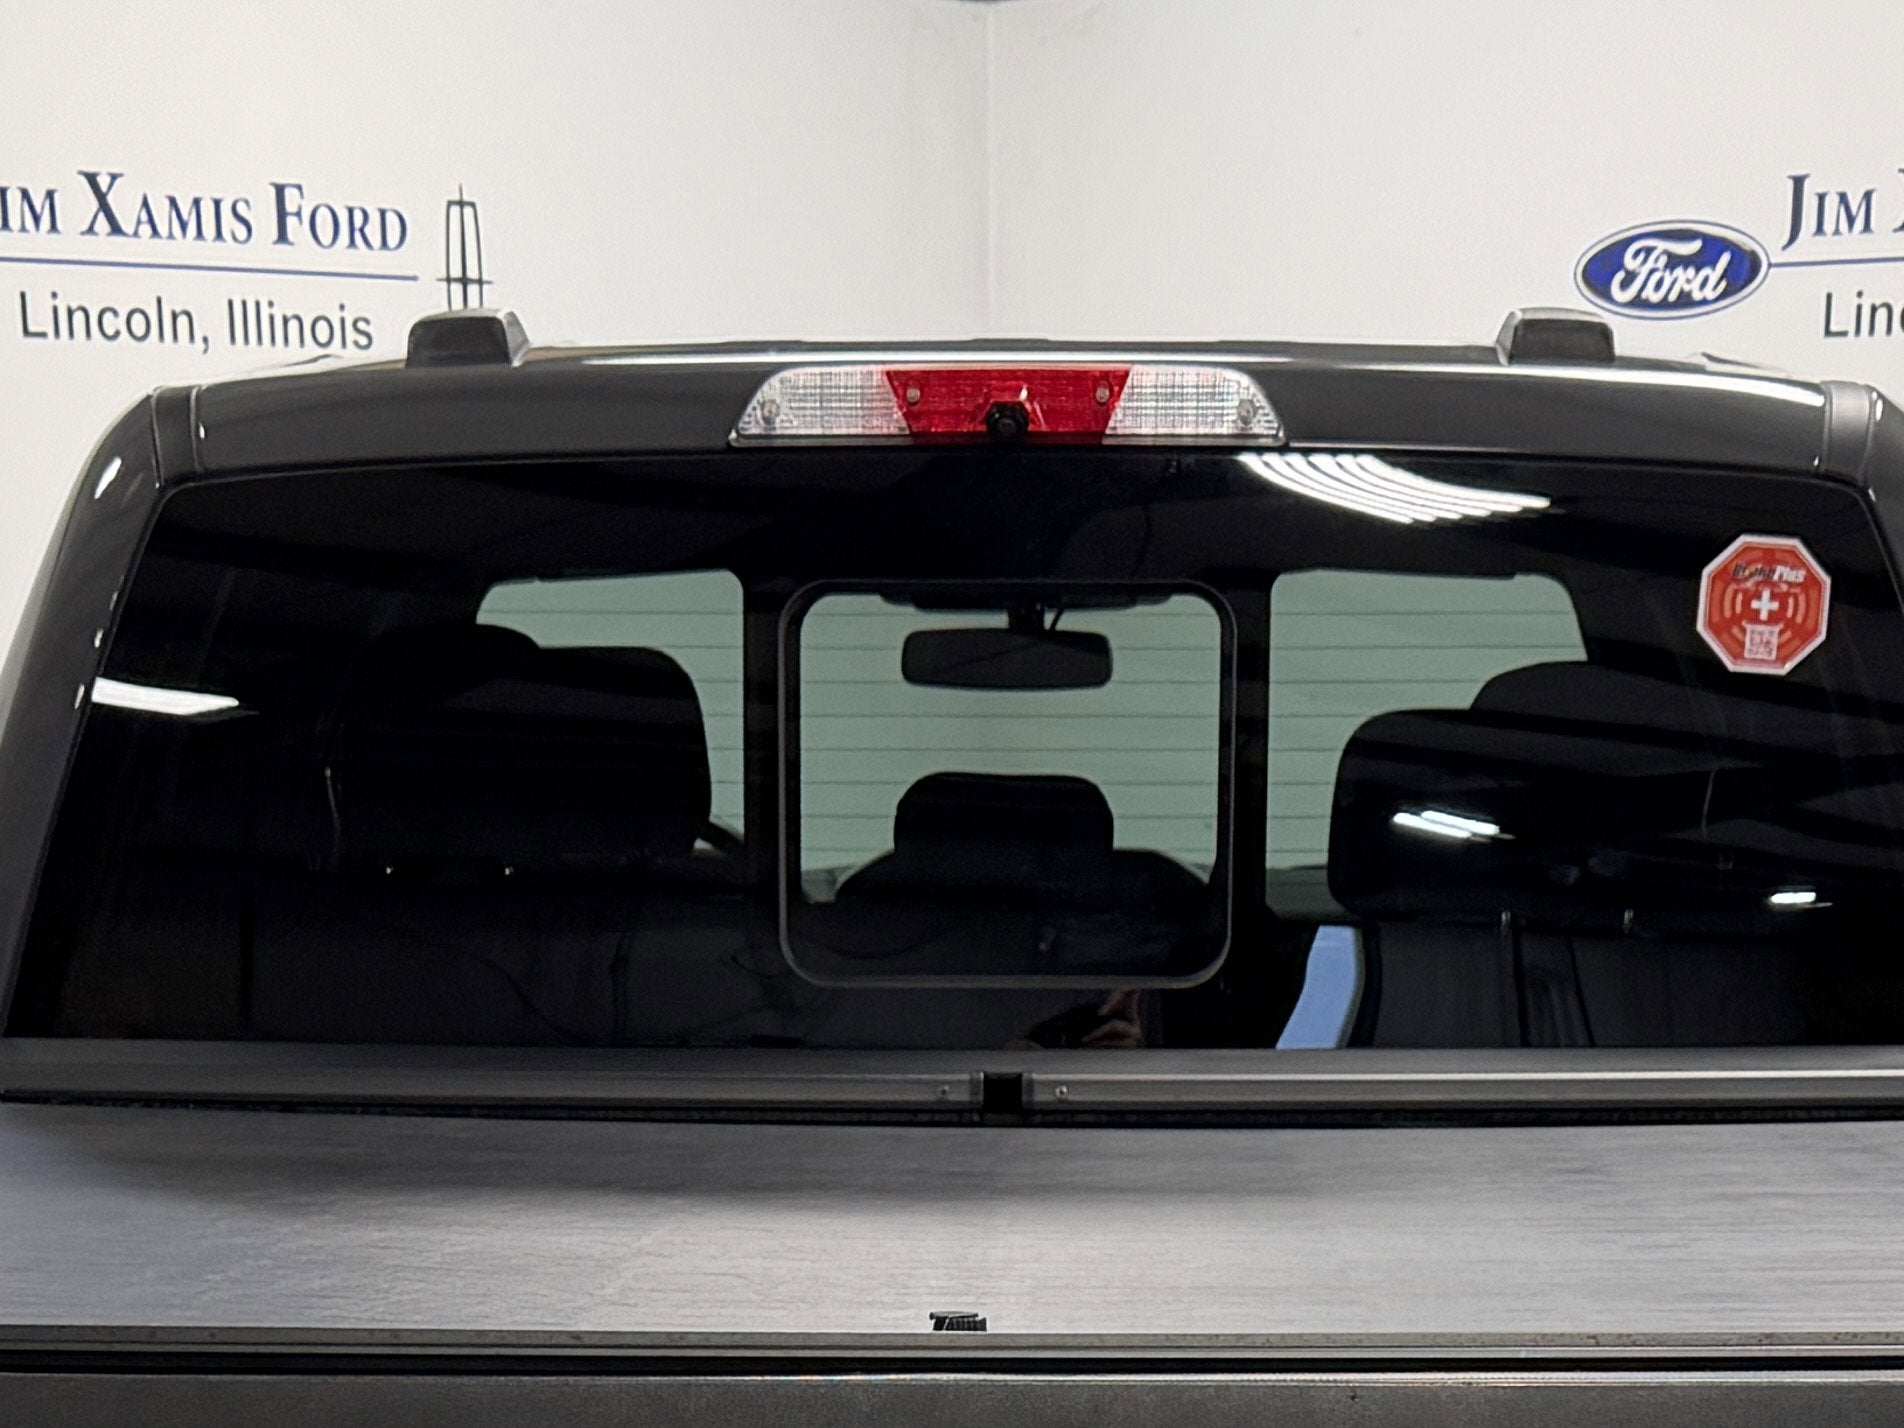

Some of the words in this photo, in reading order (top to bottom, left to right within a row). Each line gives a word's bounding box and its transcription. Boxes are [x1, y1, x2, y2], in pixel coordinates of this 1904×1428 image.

[78, 171, 252, 244] XAMIS
[270, 183, 407, 250] FORD
[1782, 174, 1874, 251] JIM
[1610, 236, 1729, 304] Ford
[20, 291, 208, 353] Lincoln,
[228, 299, 373, 351] Illinois
